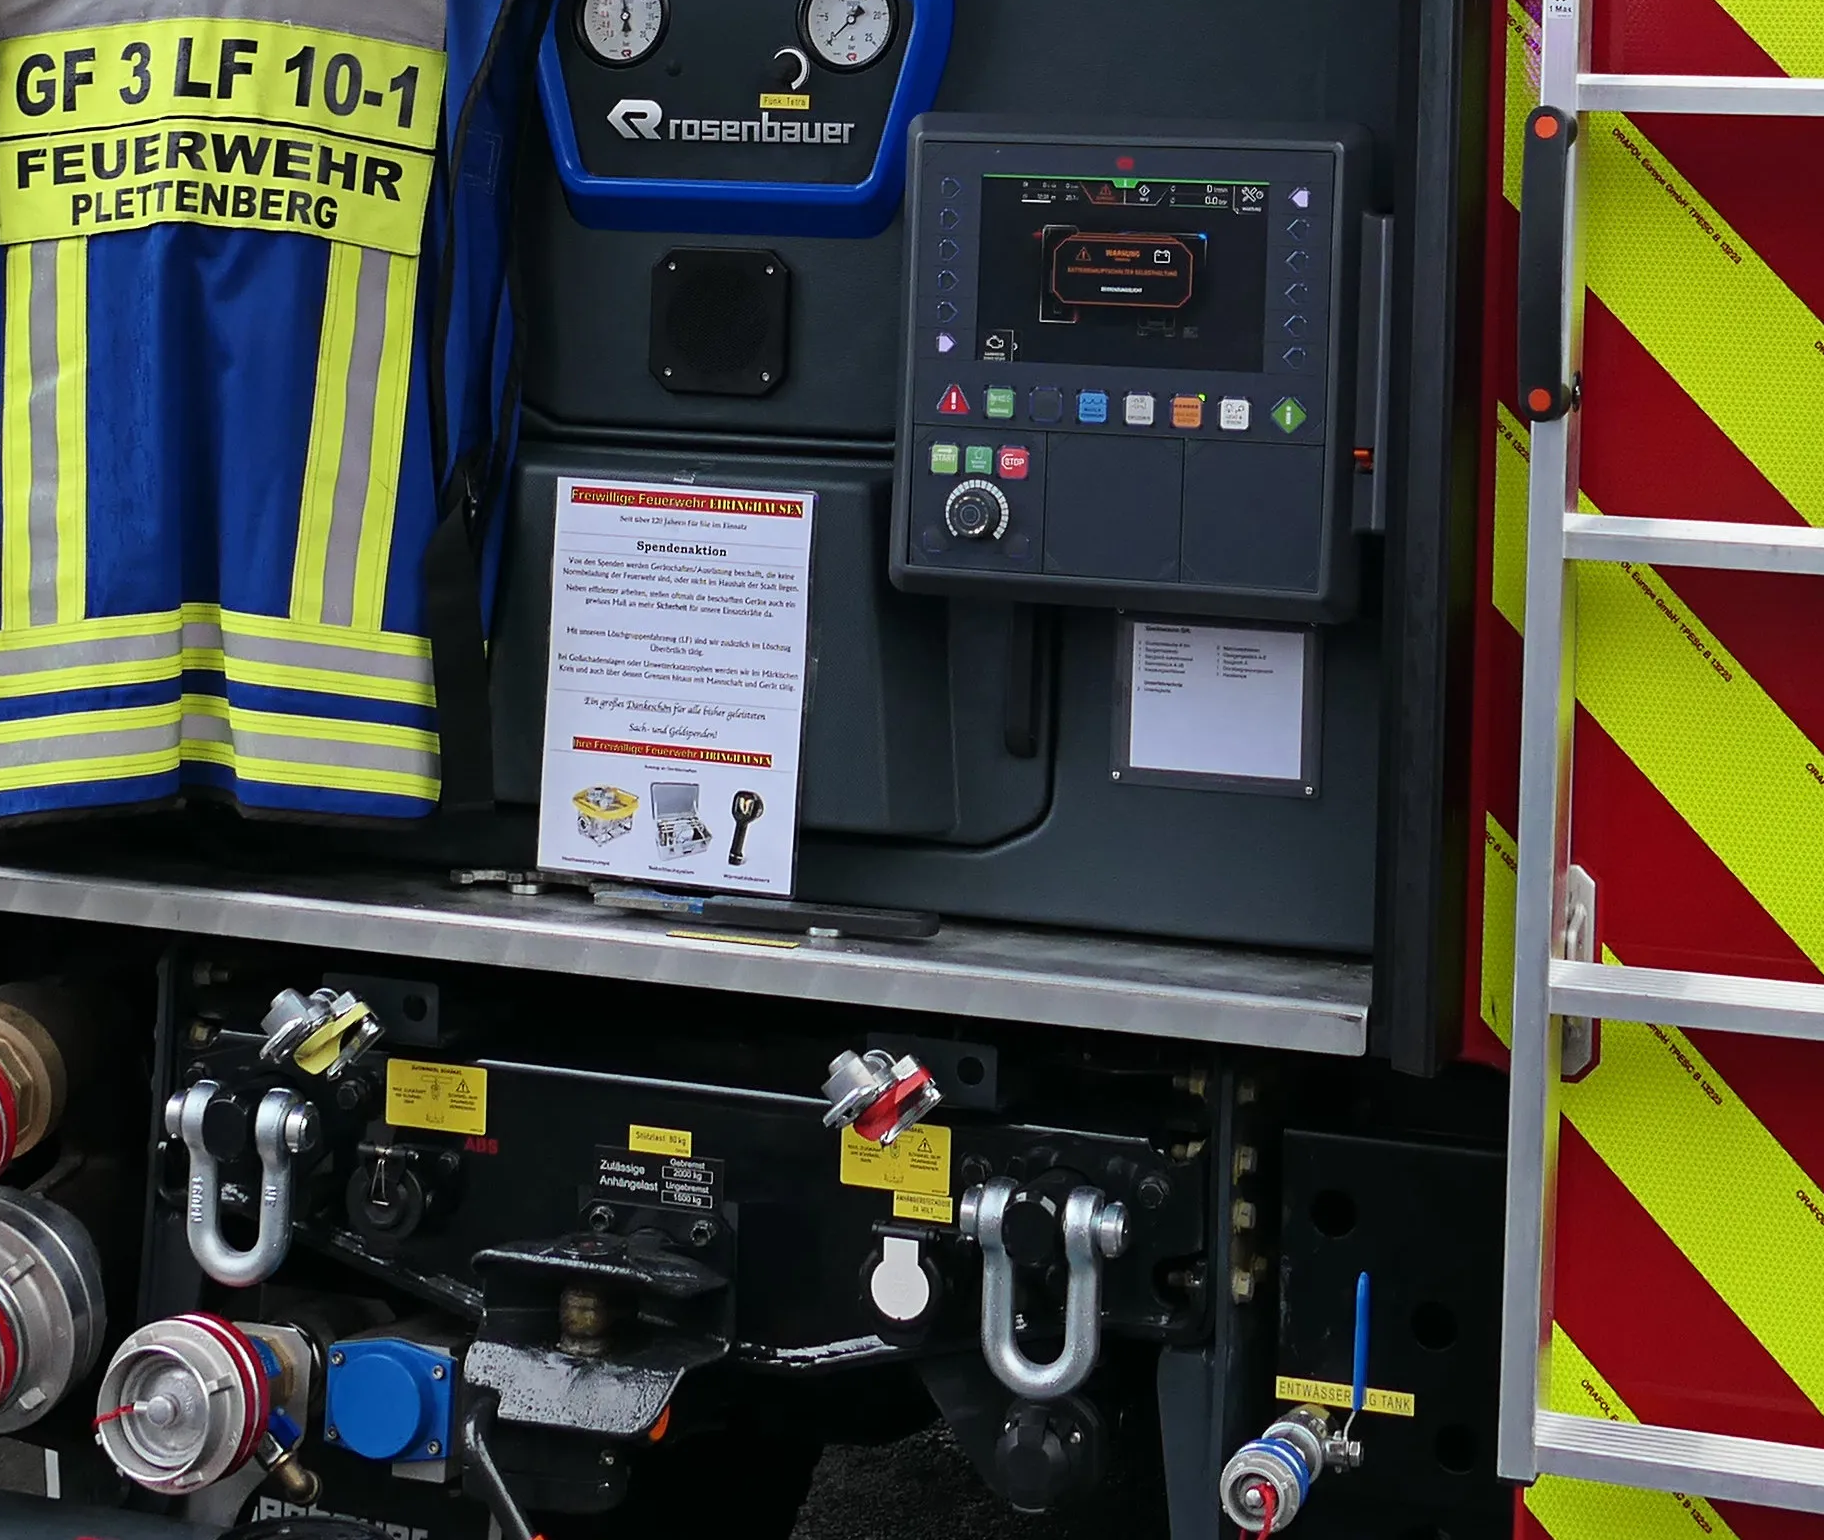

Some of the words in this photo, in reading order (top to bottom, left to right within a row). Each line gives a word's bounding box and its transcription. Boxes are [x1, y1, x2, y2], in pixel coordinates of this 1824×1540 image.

[865, 32, 873, 42] 25
[14, 46, 96, 117] GF
[119, 41, 152, 106] 3
[173, 37, 258, 100] LF
[284, 45, 420, 130] 10-1
[669, 112, 855, 144] rosenbauer
[16, 130, 404, 202] FEUERWEHR
[71, 179, 339, 230] PLETTENBERG
[1004, 457, 1024, 467] STOP
[571, 488, 634, 506] Freiwillige
[638, 493, 706, 509] Feuerwehr
[636, 540, 727, 558] Spendenaktion
[600, 1160, 645, 1176] Zulässige
[670, 1158, 705, 1170] Gebremst
[600, 1175, 658, 1191] Anhängelast
[665, 1181, 709, 1194] Ungebremst
[1279, 1381, 1376, 1406] ENTWÄSSERG
[1382, 1395, 1410, 1410] TANK
